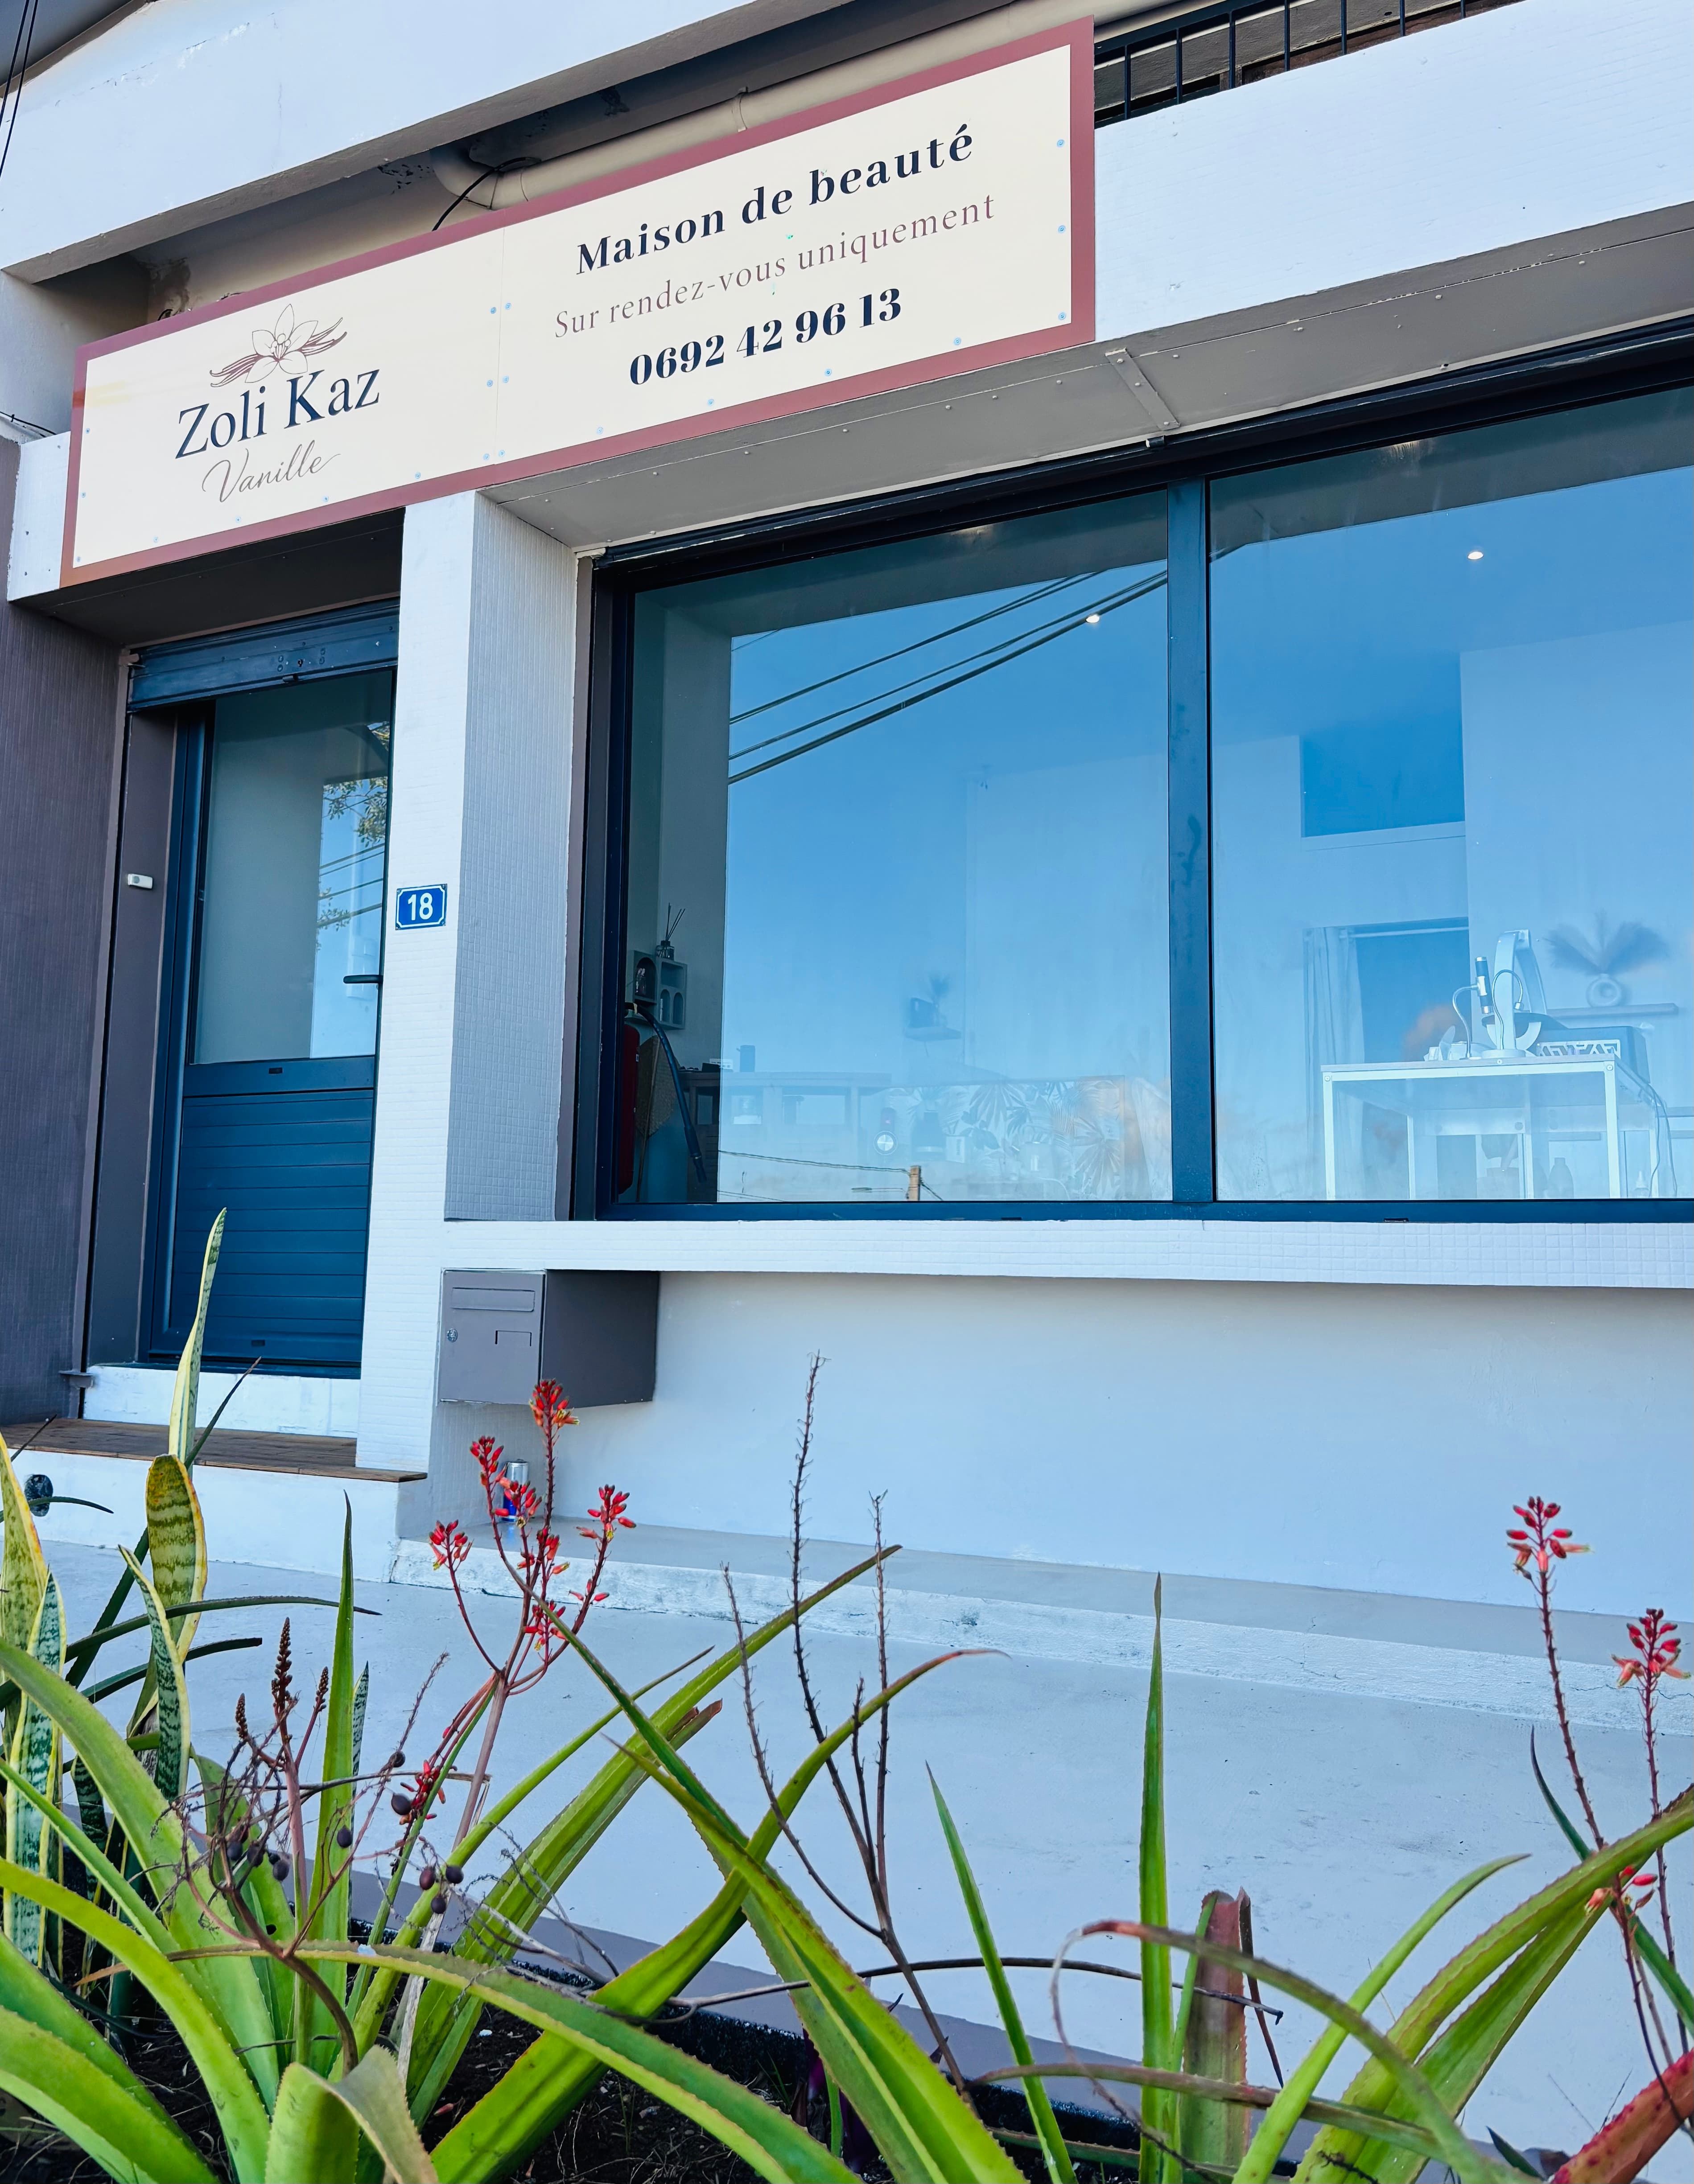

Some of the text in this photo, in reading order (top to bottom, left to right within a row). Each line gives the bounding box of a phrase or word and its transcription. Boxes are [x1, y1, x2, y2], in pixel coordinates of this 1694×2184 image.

[576, 123, 973, 275] Maison de beauté
[555, 193, 995, 338] Sur rendez-vous uniquement
[629, 288, 902, 385] 0692 42 96 13
[175, 369, 380, 460] Zoli Kaz
[202, 440, 341, 503] Vanille
[408, 893, 433, 921] 18
